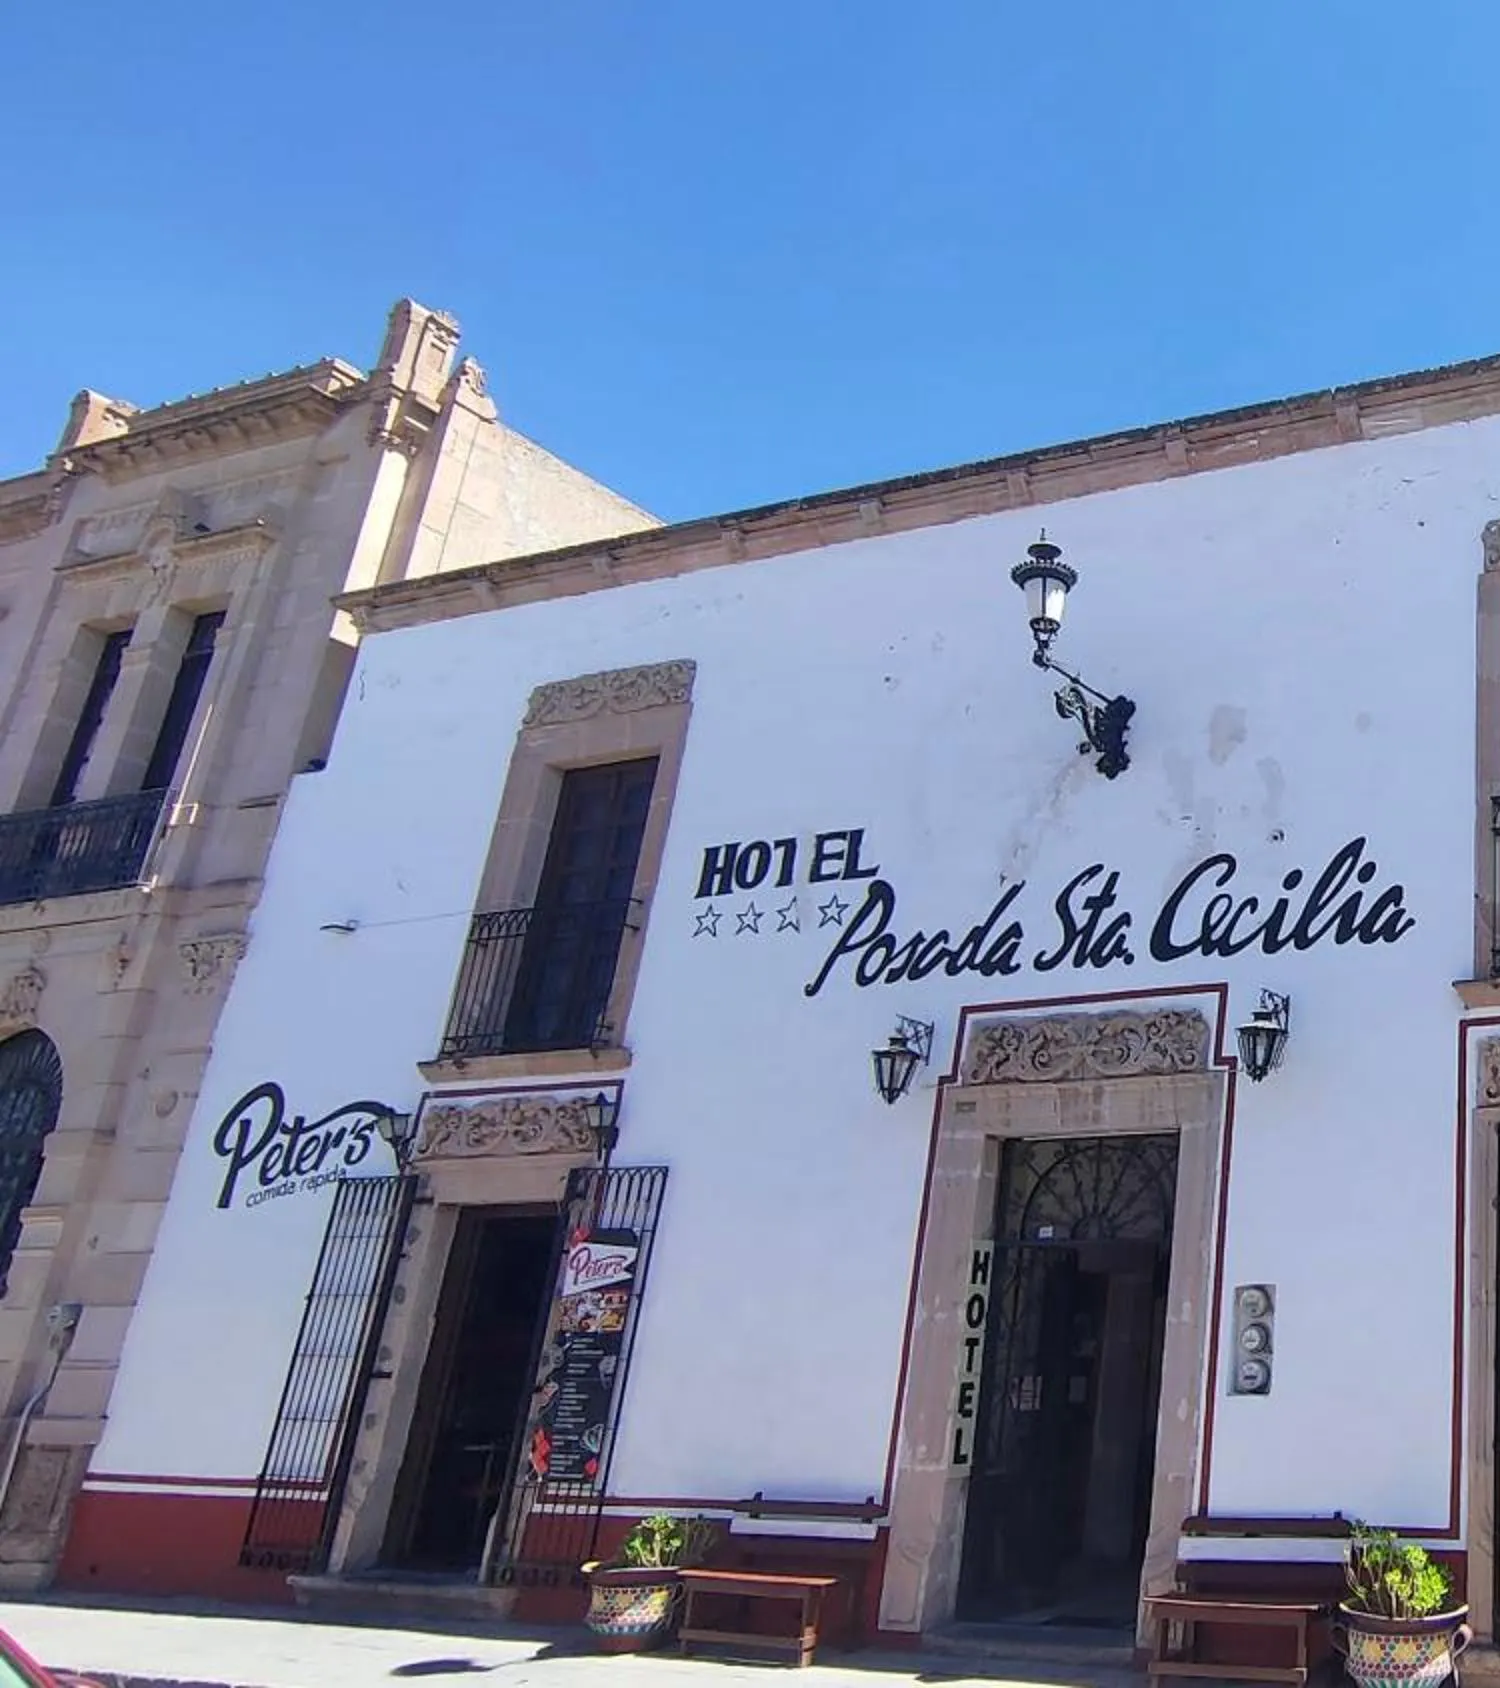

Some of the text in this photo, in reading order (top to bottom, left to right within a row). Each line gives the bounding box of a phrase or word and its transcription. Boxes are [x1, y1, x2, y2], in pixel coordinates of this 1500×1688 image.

[694, 828, 880, 899] HOTEL
[804, 836, 1416, 997] Posada Sta. Cecilia
[213, 1081, 396, 1209] Peter's
[245, 1179, 296, 1208] comida
[952, 1248, 991, 1465] HOTEL
